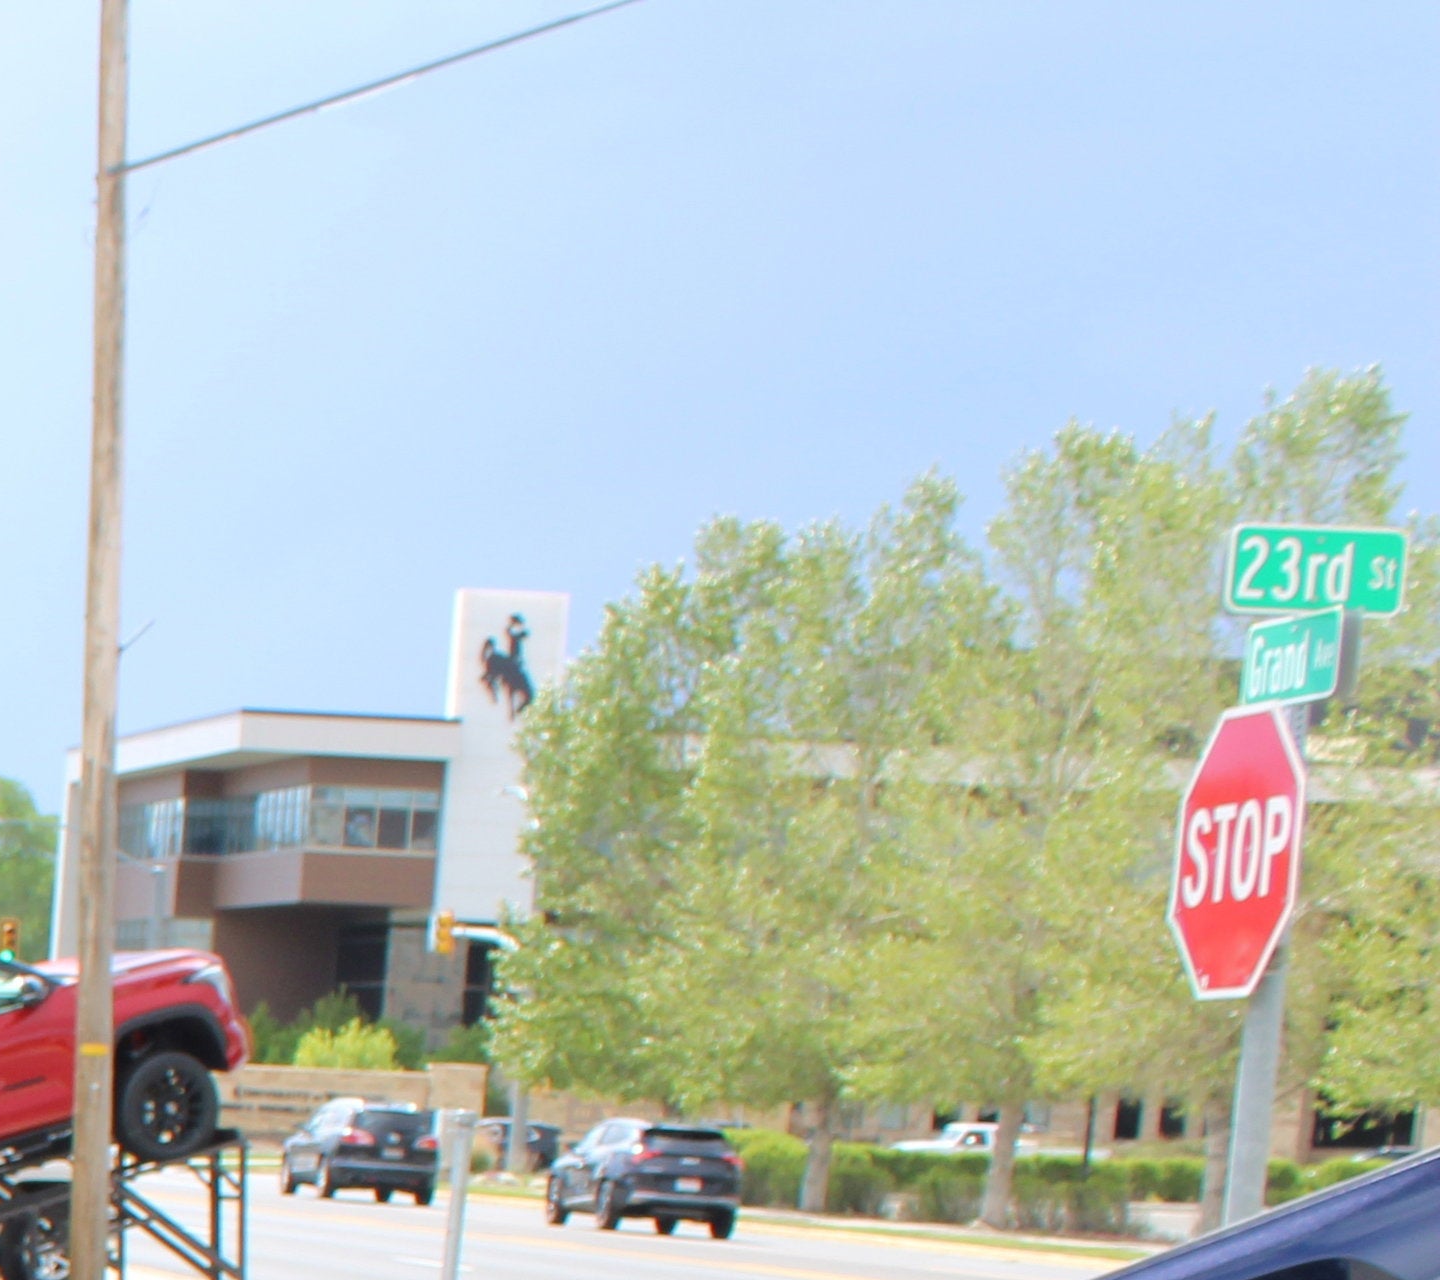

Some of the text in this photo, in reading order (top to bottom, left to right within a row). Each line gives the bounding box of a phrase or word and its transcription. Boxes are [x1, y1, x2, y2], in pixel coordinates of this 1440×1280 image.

[1236, 534, 1397, 604] 23rd St
[1249, 633, 1310, 699] Grand
[1182, 794, 1293, 909] STOP
